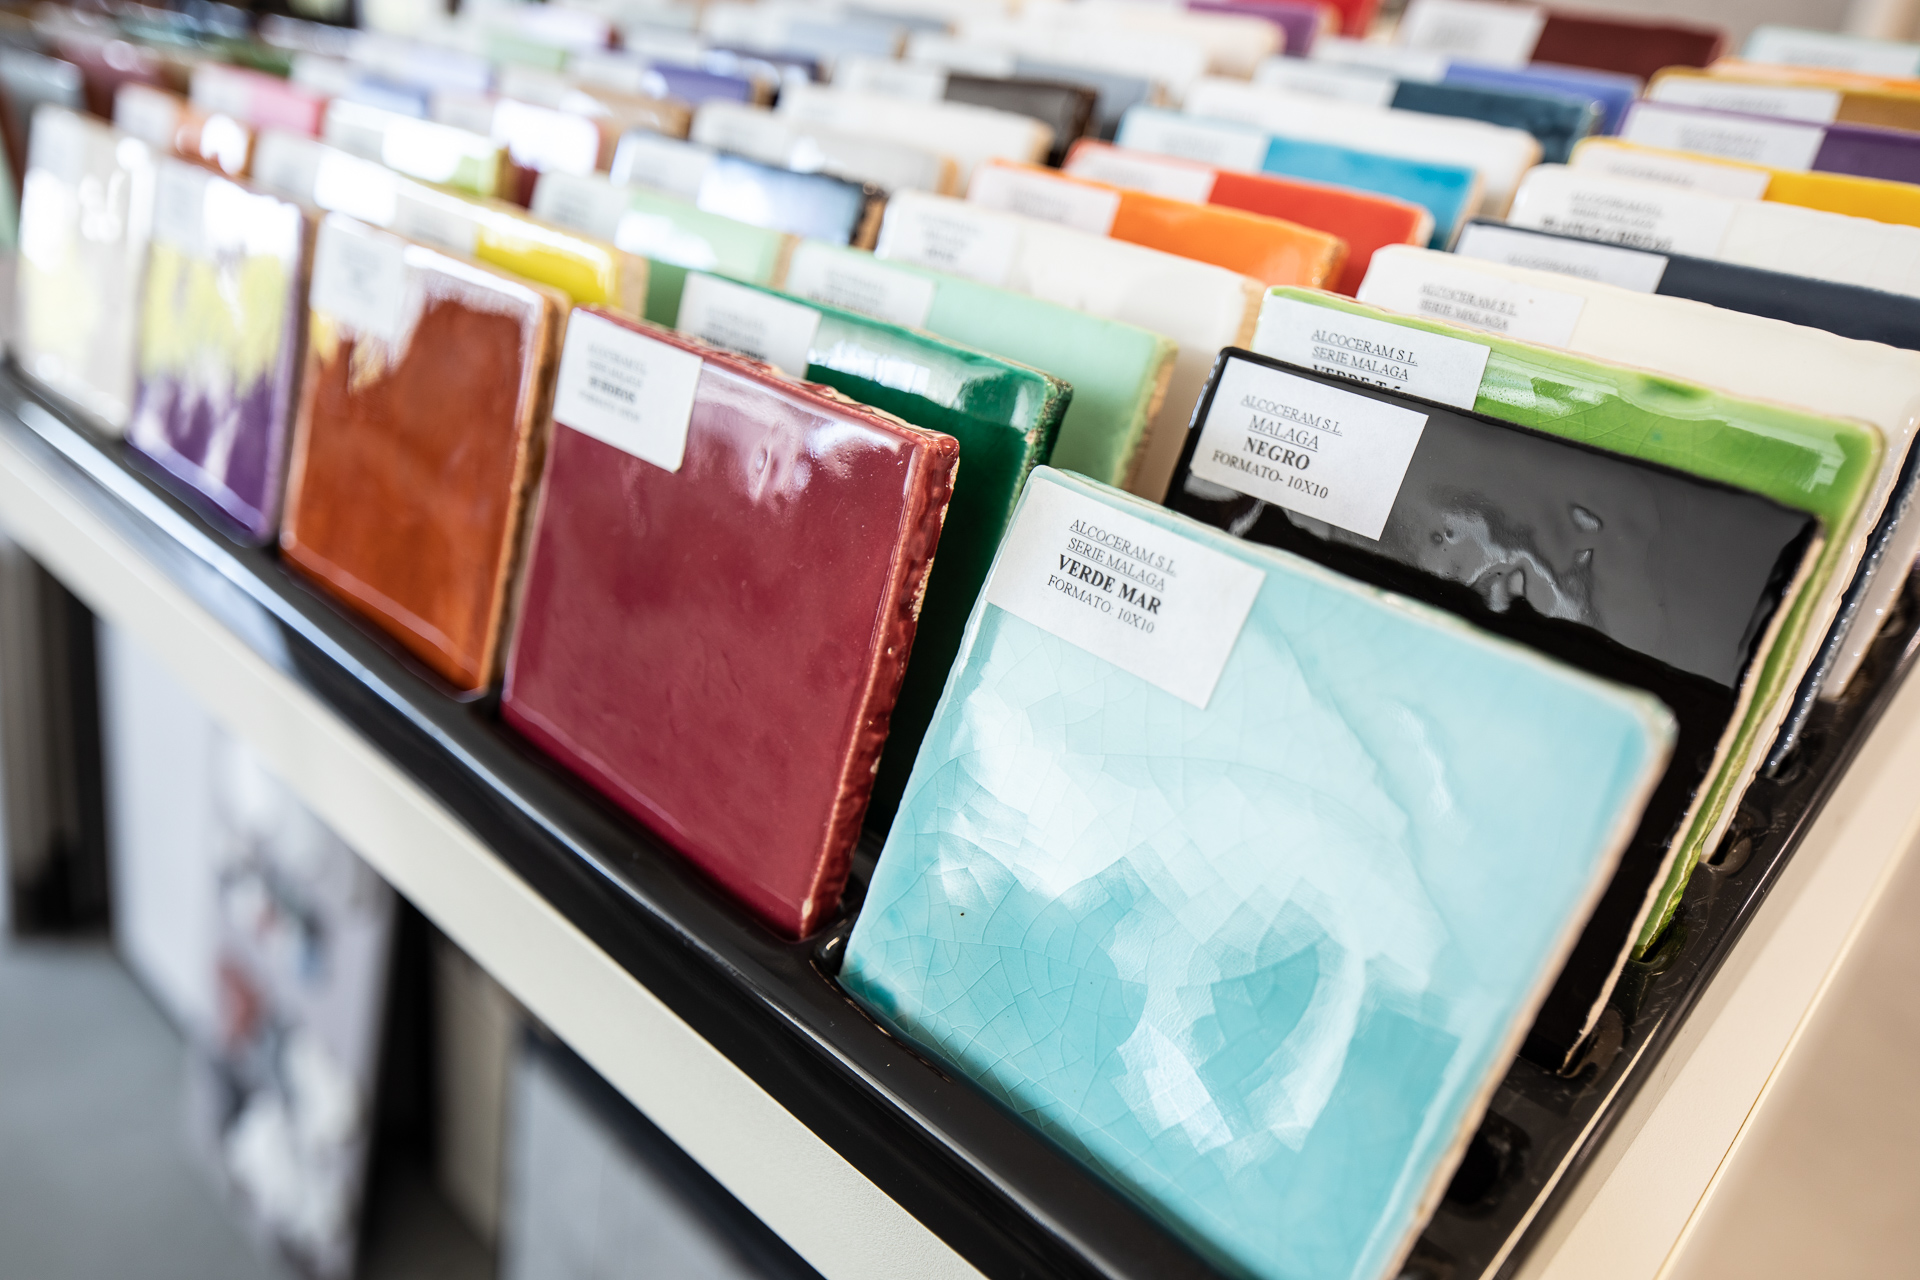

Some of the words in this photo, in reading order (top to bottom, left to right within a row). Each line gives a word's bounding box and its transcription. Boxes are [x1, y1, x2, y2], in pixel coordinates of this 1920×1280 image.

[1311, 329, 1395, 358] ALCOCERAM
[1312, 346, 1349, 364] SERIE
[1350, 355, 1409, 380] MALAGA
[1241, 394, 1322, 427] ALCOCERAM
[1248, 414, 1319, 450] MALAGA
[1242, 436, 1310, 470] NEGRO
[1212, 449, 1283, 482] FORMATO-
[1287, 475, 1329, 499] 10X10
[1070, 519, 1155, 564] ALCOCERAM
[1059, 553, 1116, 593] VERDE
[1117, 582, 1161, 615] MAR
[1068, 537, 1106, 563] SERIE
[1106, 554, 1165, 591] MALAGA
[1047, 574, 1114, 615] FORMATO:
[1117, 607, 1155, 634] 10X10
